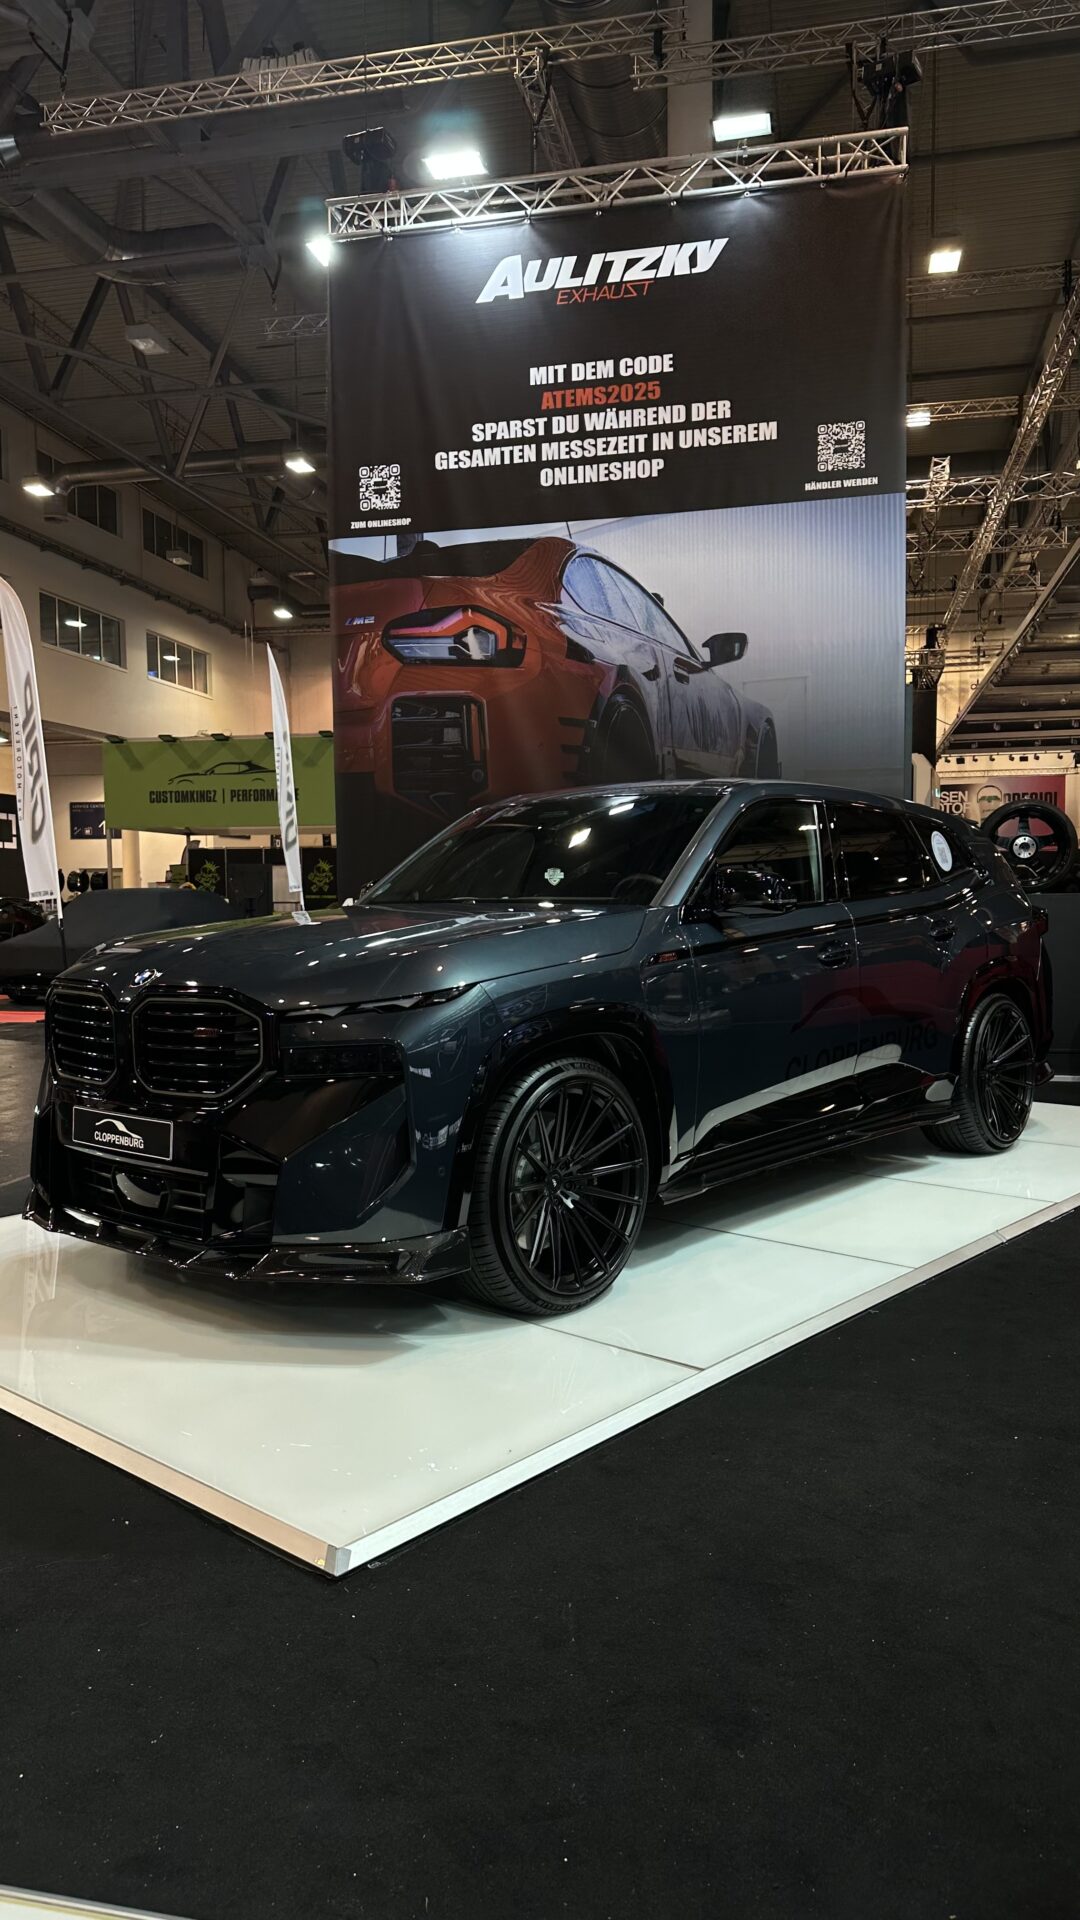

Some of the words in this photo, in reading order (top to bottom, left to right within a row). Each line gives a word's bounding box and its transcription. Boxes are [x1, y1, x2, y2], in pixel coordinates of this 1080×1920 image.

[475, 237, 730, 304] AULITZKY
[556, 280, 655, 305] EXHAUST
[529, 364, 567, 386] MIT
[571, 359, 615, 382] DEM
[619, 353, 674, 377] CODE
[541, 380, 661, 410] ATEMS2025
[471, 417, 548, 442] SPARST
[552, 414, 579, 435] DU
[583, 404, 686, 431] WÄHREND
[691, 400, 732, 422] DER
[434, 443, 537, 470] GESAMTEN
[541, 434, 648, 461] MESSEZEIT
[652, 431, 674, 452] IN
[678, 421, 778, 449] UNSEREM
[540, 458, 665, 487] ONLINESHOP
[804, 480, 842, 491] HÄNDLER
[843, 476, 879, 488] WERDEN
[350, 520, 367, 529] ZUM
[367, 517, 412, 528] ONLINESHOP
[149, 789, 217, 803] CUSTOMKINGZ
[230, 788, 299, 803] PERFORME
[94, 1130, 145, 1149] CLOPPENBURG
